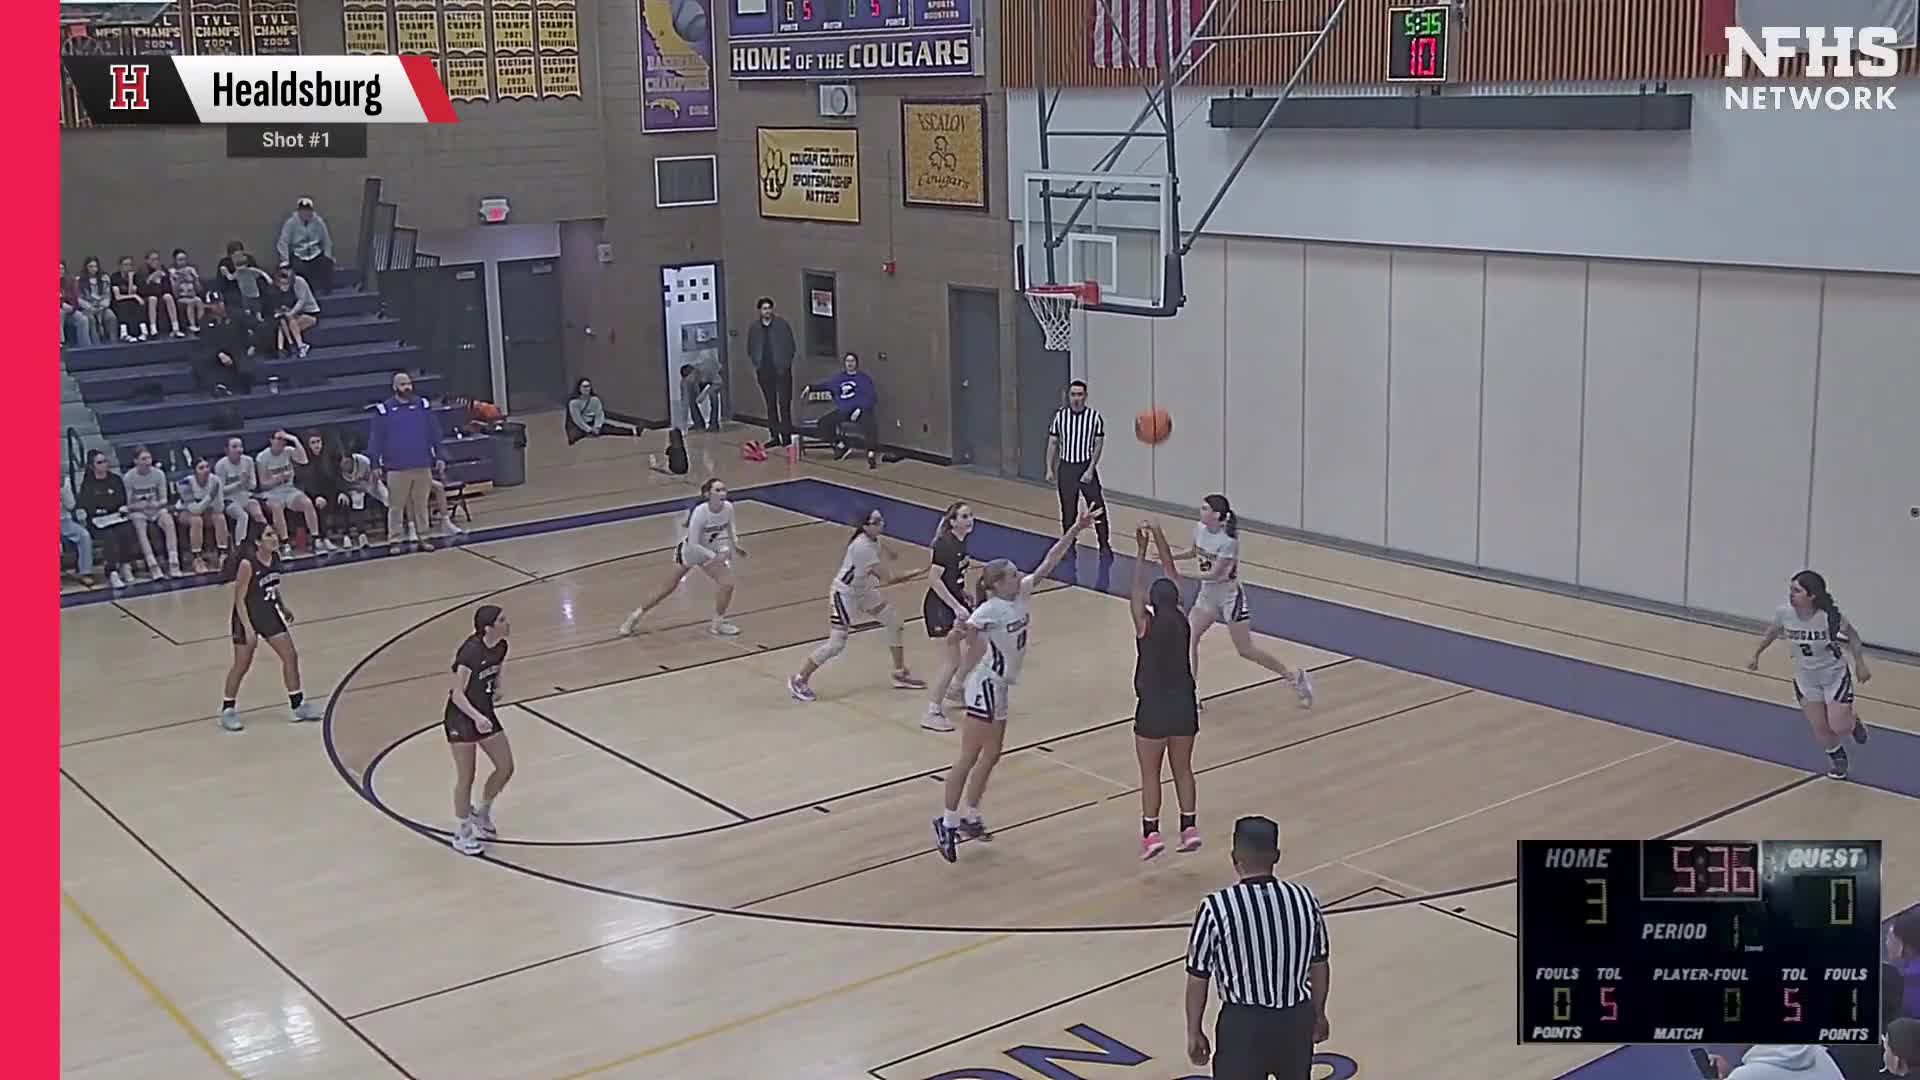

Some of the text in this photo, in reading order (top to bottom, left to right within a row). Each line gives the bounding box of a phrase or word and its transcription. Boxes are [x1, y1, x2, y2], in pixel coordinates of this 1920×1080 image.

[347, 22, 384, 31] CHAMPS
[400, 22, 434, 30] CHAMPS
[448, 22, 481, 30] CHAMPS
[1404, 13, 1441, 35] 5:35
[134, 27, 180, 38] CHAMPS
[195, 26, 240, 38] CHAMPS
[255, 25, 297, 37] CHAMPS
[733, 39, 969, 71] HOME OF THE COUGARS
[1408, 36, 1437, 76] 10
[449, 69, 484, 77] CHAMPS
[499, 68, 532, 76] CHAMPS
[543, 67, 576, 75] CHAMPS
[790, 153, 854, 168] COUGAR COUNTRY
